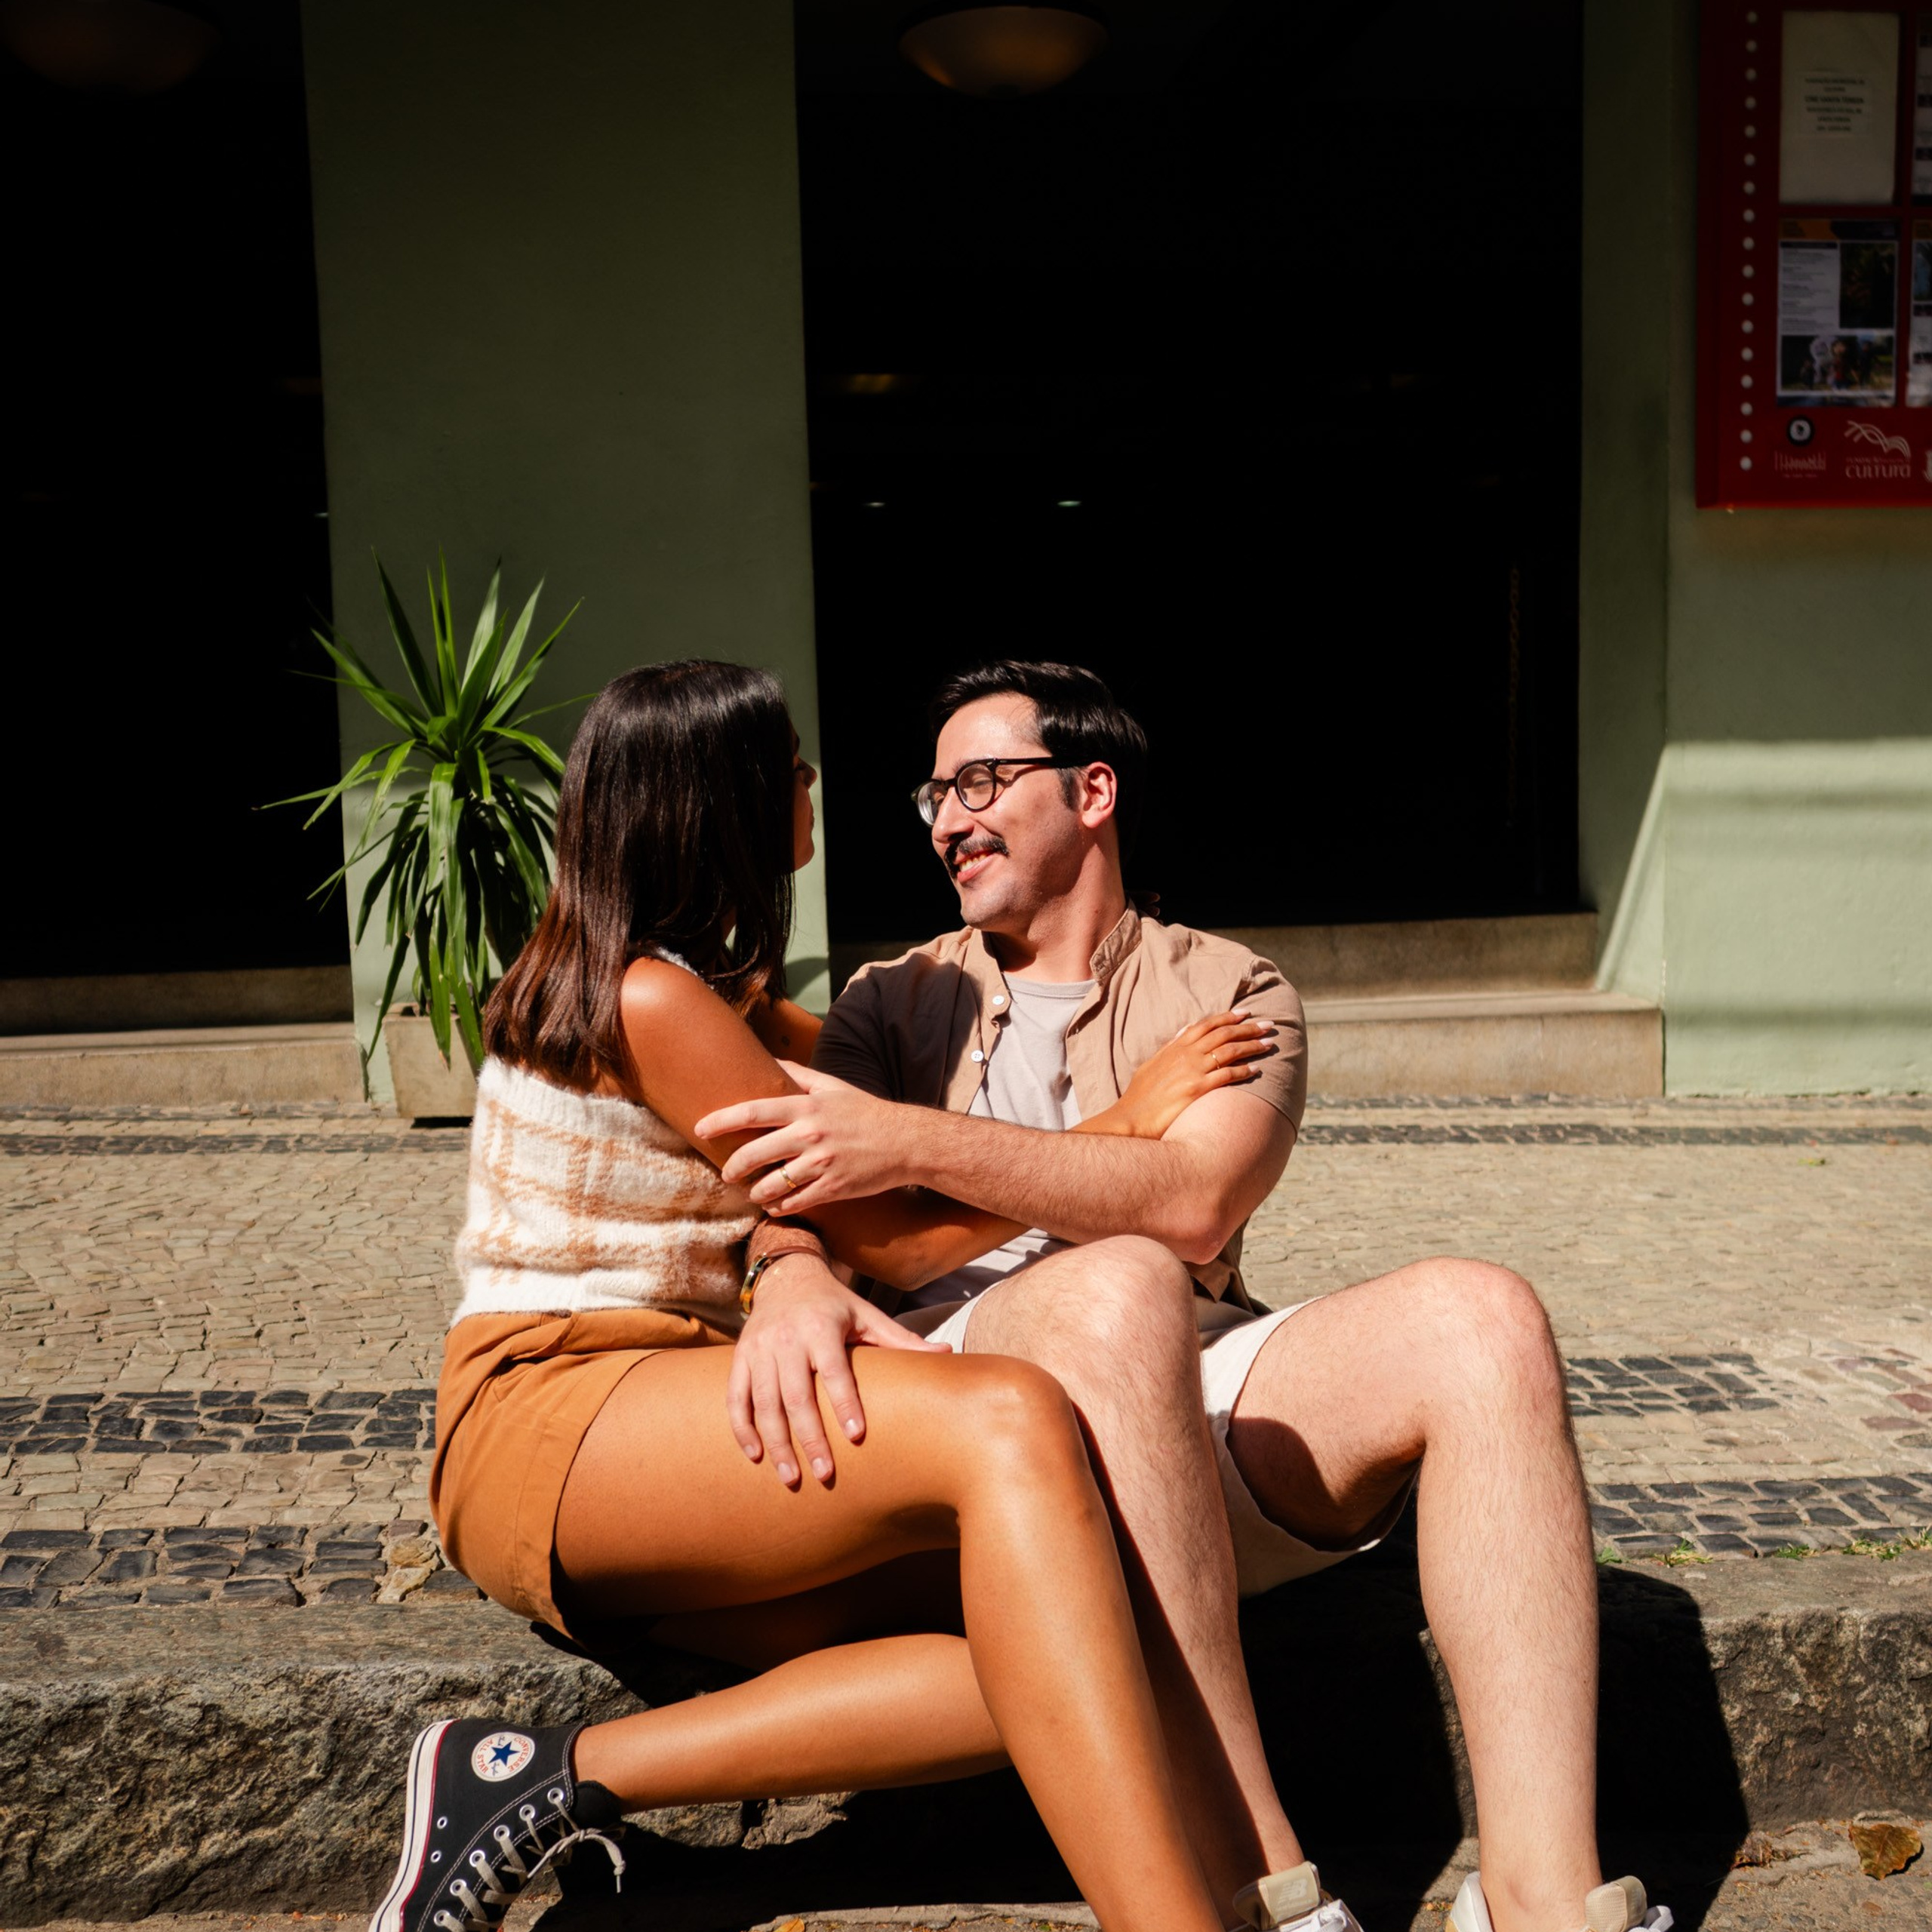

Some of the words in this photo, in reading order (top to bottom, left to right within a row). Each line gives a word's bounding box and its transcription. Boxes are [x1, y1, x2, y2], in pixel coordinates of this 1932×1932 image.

[480, 1739, 494, 1752] ALL
[509, 1737, 530, 1773] CONVERSE
[477, 1755, 489, 1774] STAR
